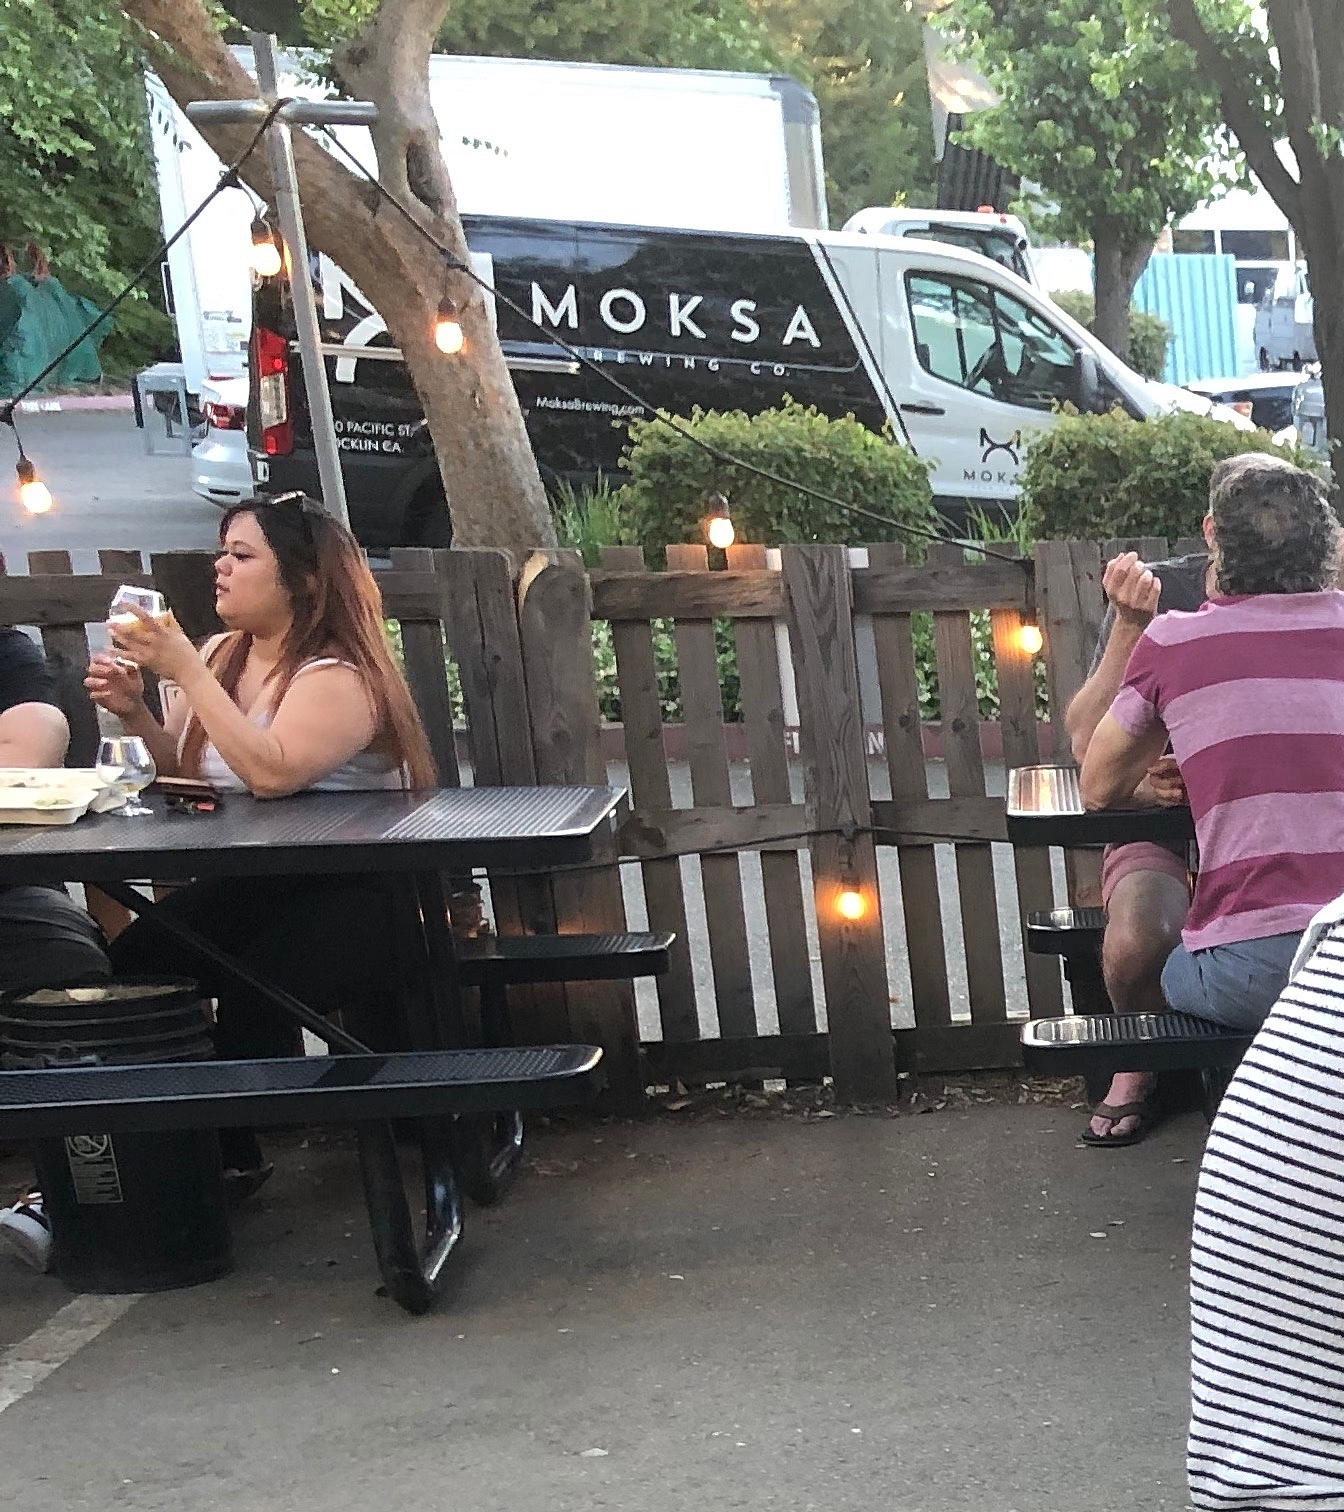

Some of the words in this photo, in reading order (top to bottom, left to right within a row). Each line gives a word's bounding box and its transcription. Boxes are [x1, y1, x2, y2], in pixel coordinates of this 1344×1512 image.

[531, 281, 822, 348] MOKSA
[571, 346, 720, 372] REWING
[347, 421, 395, 436] PACIFIC
